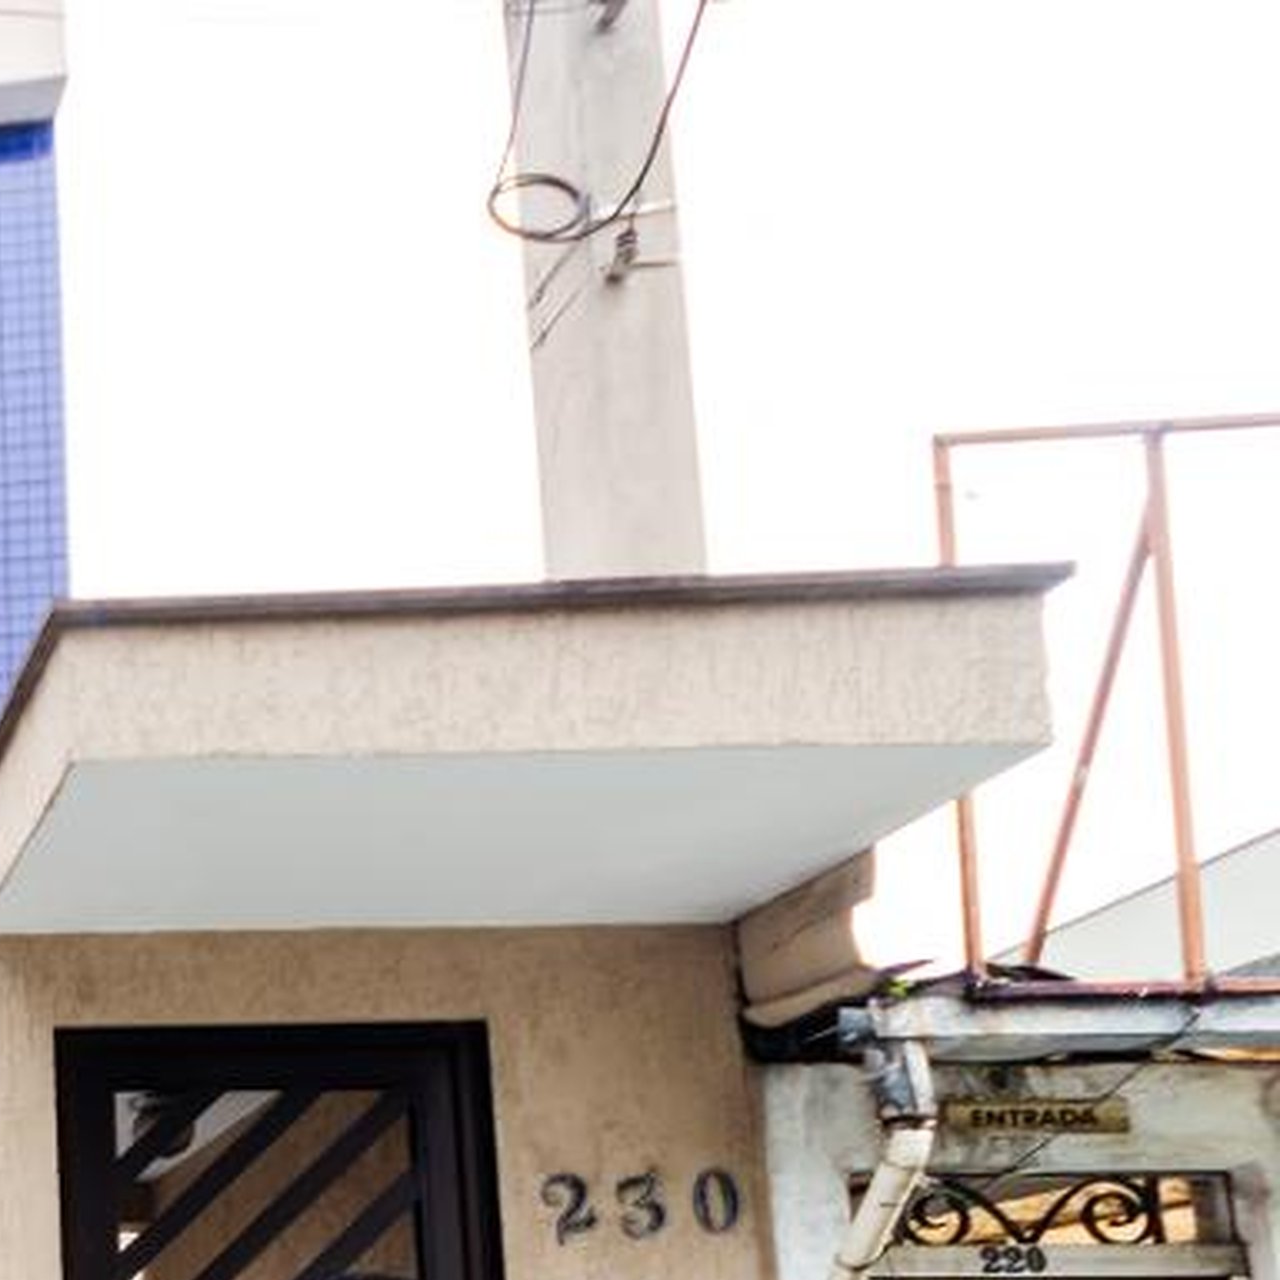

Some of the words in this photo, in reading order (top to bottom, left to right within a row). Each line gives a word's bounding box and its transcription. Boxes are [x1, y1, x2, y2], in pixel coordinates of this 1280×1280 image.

[970, 1108, 1098, 1127] ENTRADA
[540, 1167, 741, 1246] 230
[979, 1246, 1047, 1273] 220
